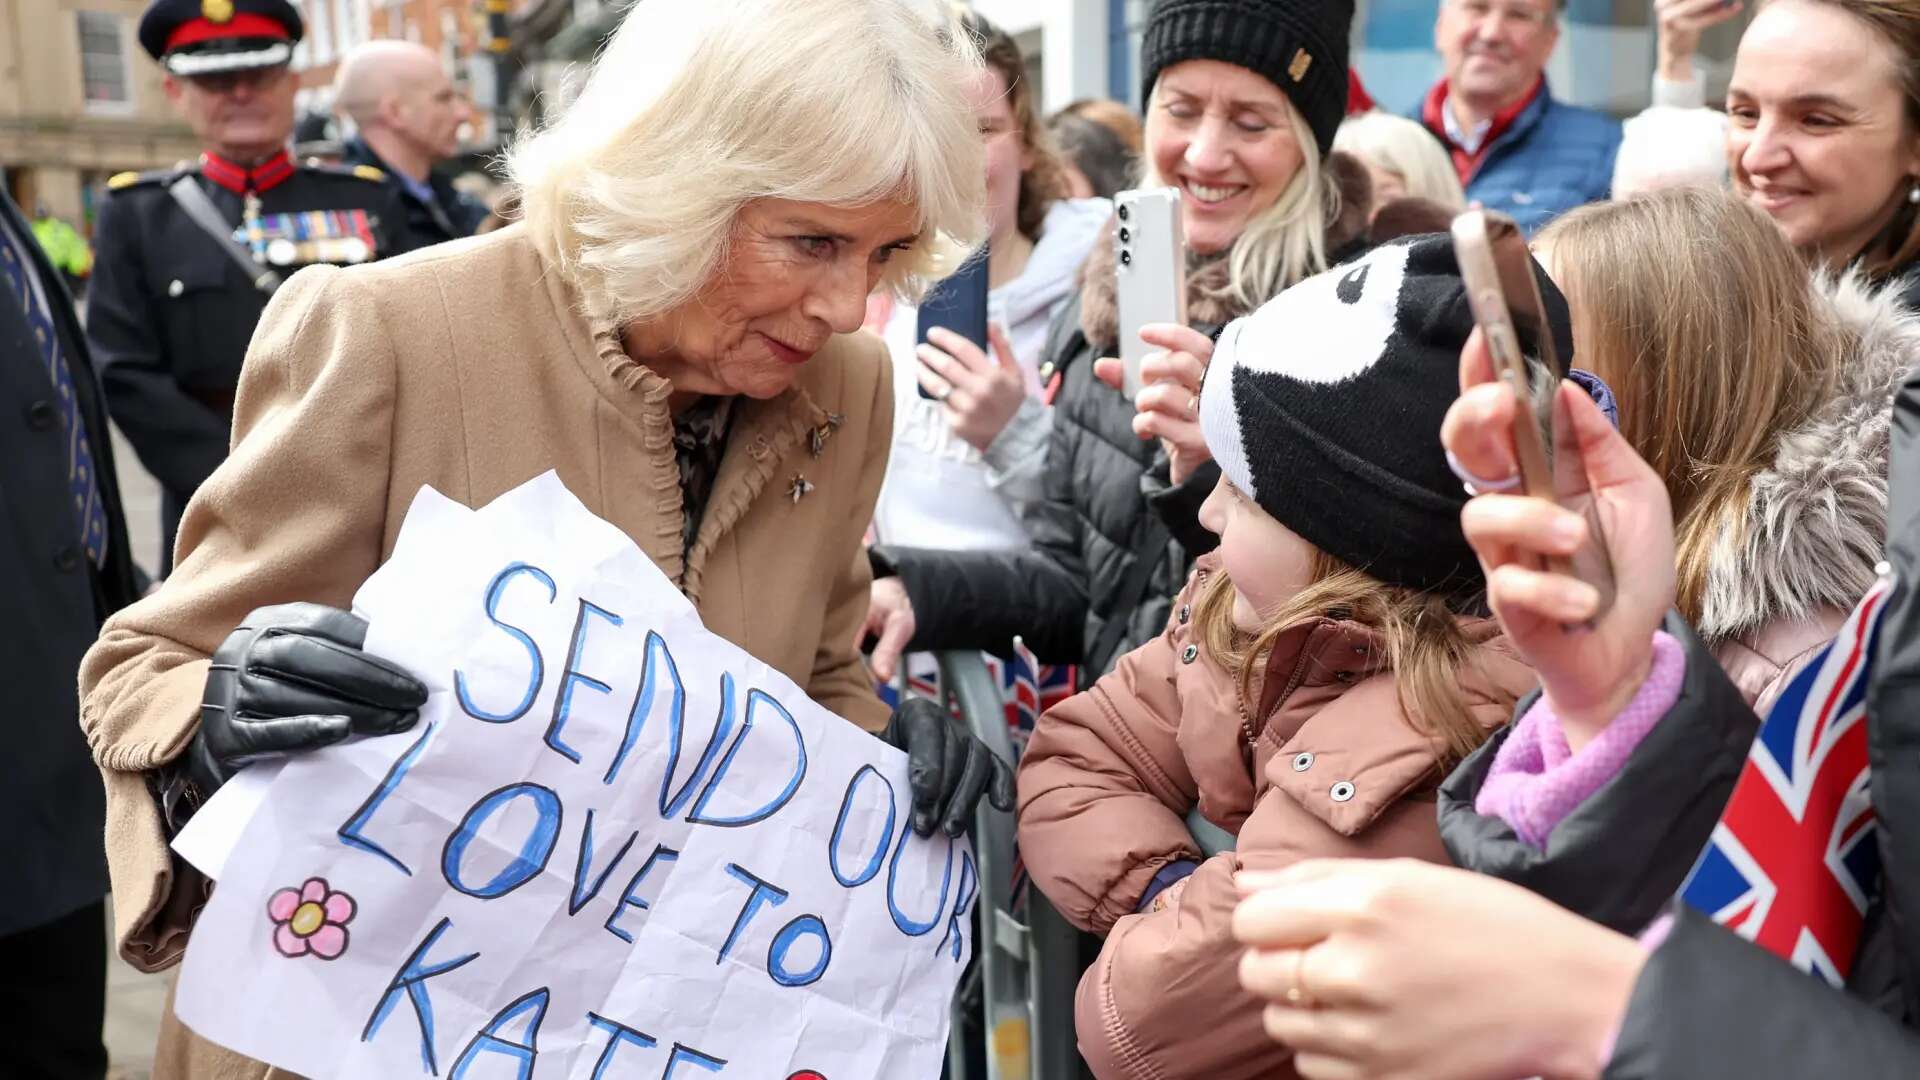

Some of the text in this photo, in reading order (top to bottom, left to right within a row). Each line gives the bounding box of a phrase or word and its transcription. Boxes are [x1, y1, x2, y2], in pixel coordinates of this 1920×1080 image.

[336, 721, 833, 988] LOVE TO
[453, 560, 977, 963] SEND OUR
